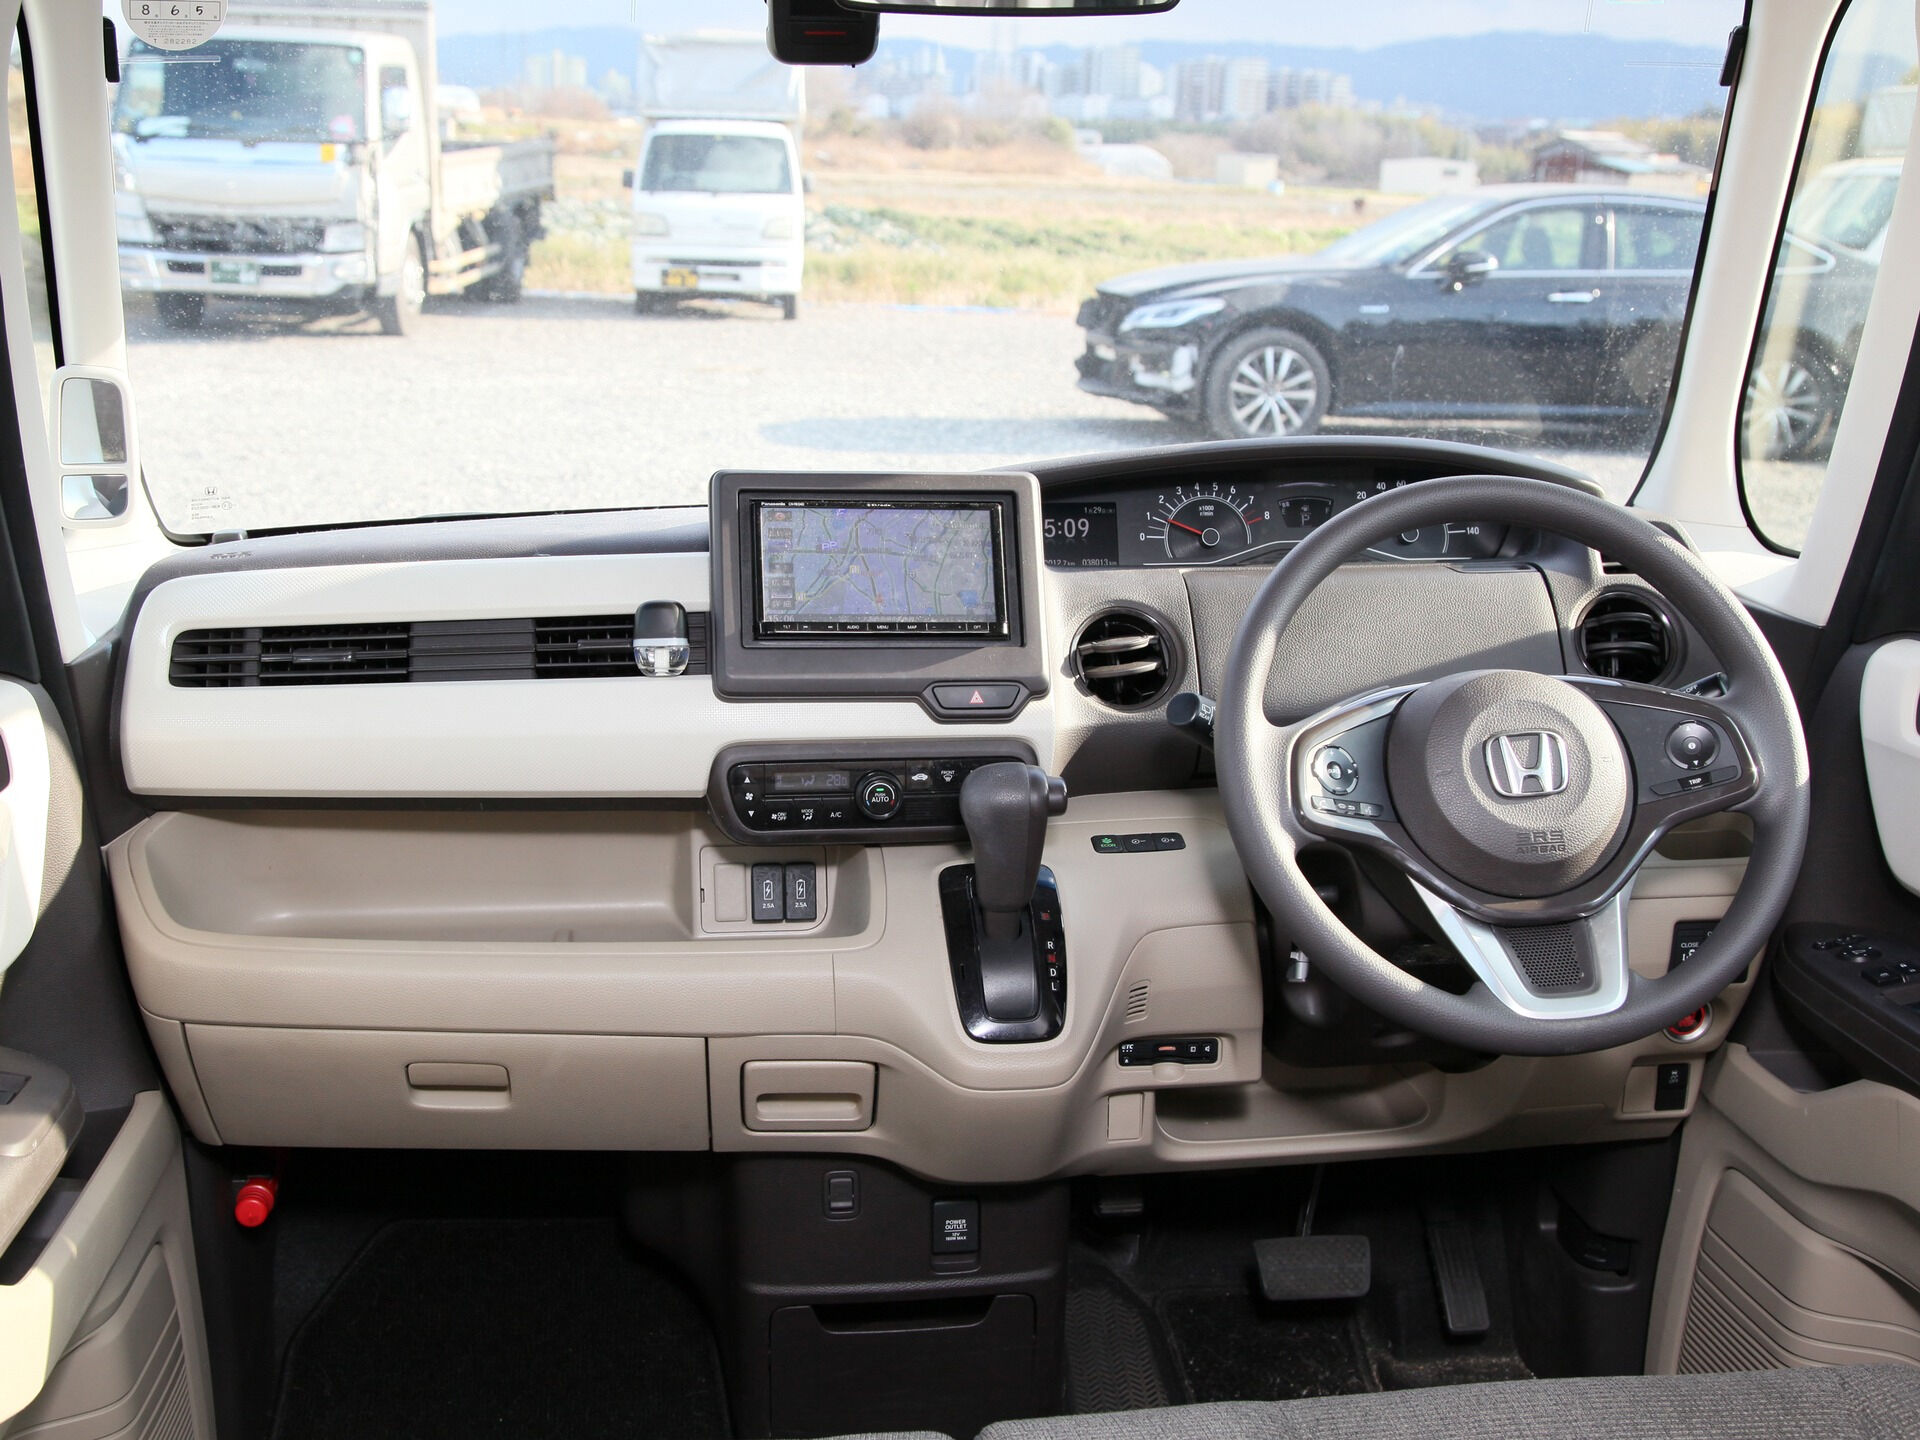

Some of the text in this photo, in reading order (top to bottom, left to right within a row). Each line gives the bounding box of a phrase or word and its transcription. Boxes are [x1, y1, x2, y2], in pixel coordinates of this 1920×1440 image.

[141, 4, 204, 16] 8 6 5
[1193, 482, 1200, 491] 4
[1212, 482, 1219, 491] 5
[1376, 481, 1386, 490] 40
[1175, 486, 1182, 495] 3
[1230, 486, 1236, 495] 6
[1356, 491, 1367, 499] 20
[1158, 495, 1164, 504] 2
[1248, 496, 1255, 505] 7
[1264, 512, 1271, 520] 8
[1466, 526, 1480, 536] 140
[1139, 532, 1146, 542] 0
[1047, 941, 1054, 949] R
[1050, 968, 1057, 977] D
[1051, 982, 1057, 991] L
